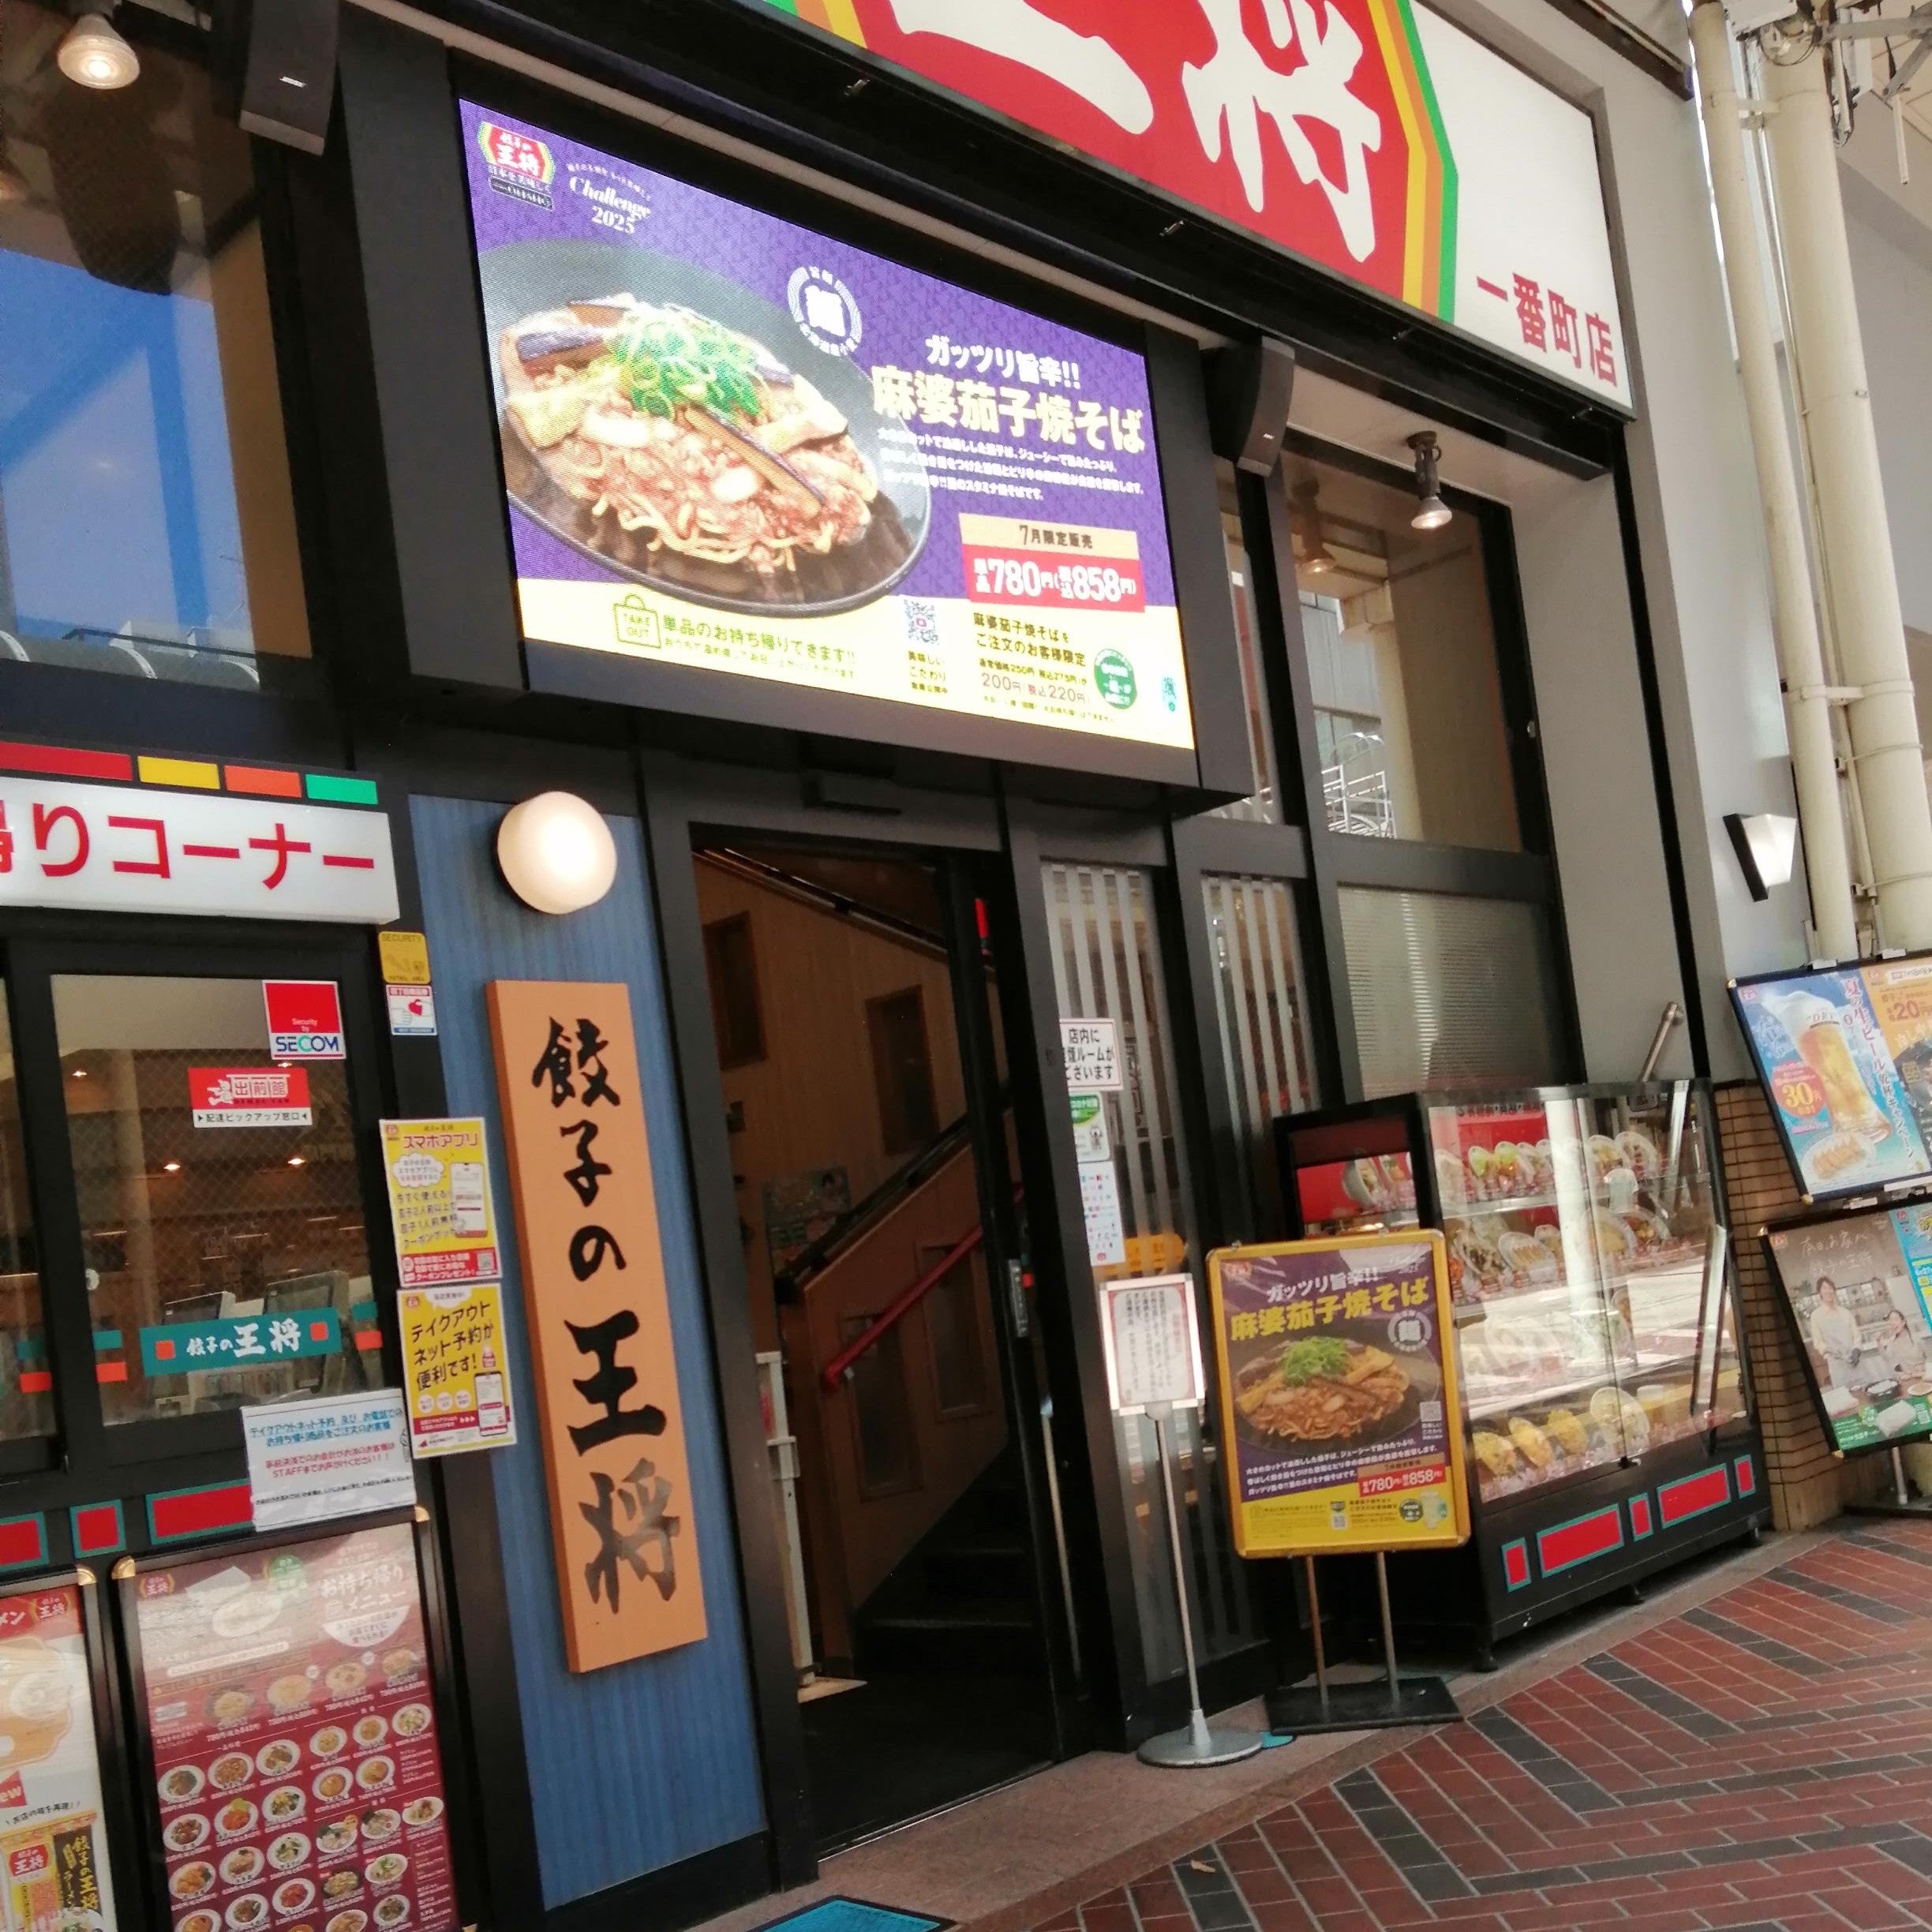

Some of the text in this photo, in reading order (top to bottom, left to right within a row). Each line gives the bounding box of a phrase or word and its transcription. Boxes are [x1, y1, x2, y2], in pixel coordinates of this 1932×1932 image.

[897, 0, 1381, 263] 将
[568, 175, 652, 222] Challenge
[591, 204, 636, 235] 2025
[1476, 271, 1618, 390] 一番町店
[871, 365, 1145, 454] 麻婆茄子焼そば
[1019, 524, 1094, 550] 7月限定販売
[973, 612, 1069, 643] 麻婆茄子焼そばを
[977, 633, 1086, 667] ご注文のお客様限定
[0, 799, 375, 890] りコーナー
[291, 1017, 318, 1027] Security
[1069, 1028, 1100, 1044] 店内に
[275, 1035, 339, 1053] SECOM
[1064, 1046, 1114, 1063] 煙ルームが
[234, 1080, 286, 1097] 出前館
[206, 1109, 300, 1122] 配達ピックアップ窓口
[403, 1133, 478, 1149] スマホアプリ
[411, 1301, 491, 1343] テイクアウト
[531, 1016, 680, 1616] 餃子の王将
[1230, 1276, 1429, 1342] 麻婆茄子焼そば
[186, 1317, 301, 1357] 餃子の王将
[414, 1323, 494, 1365] ネット予約が
[417, 1353, 477, 1391] 便利です!
[38, 1603, 66, 1619] 王将
[0, 1786, 23, 1803] ew
[14, 1855, 45, 1875] 王将
